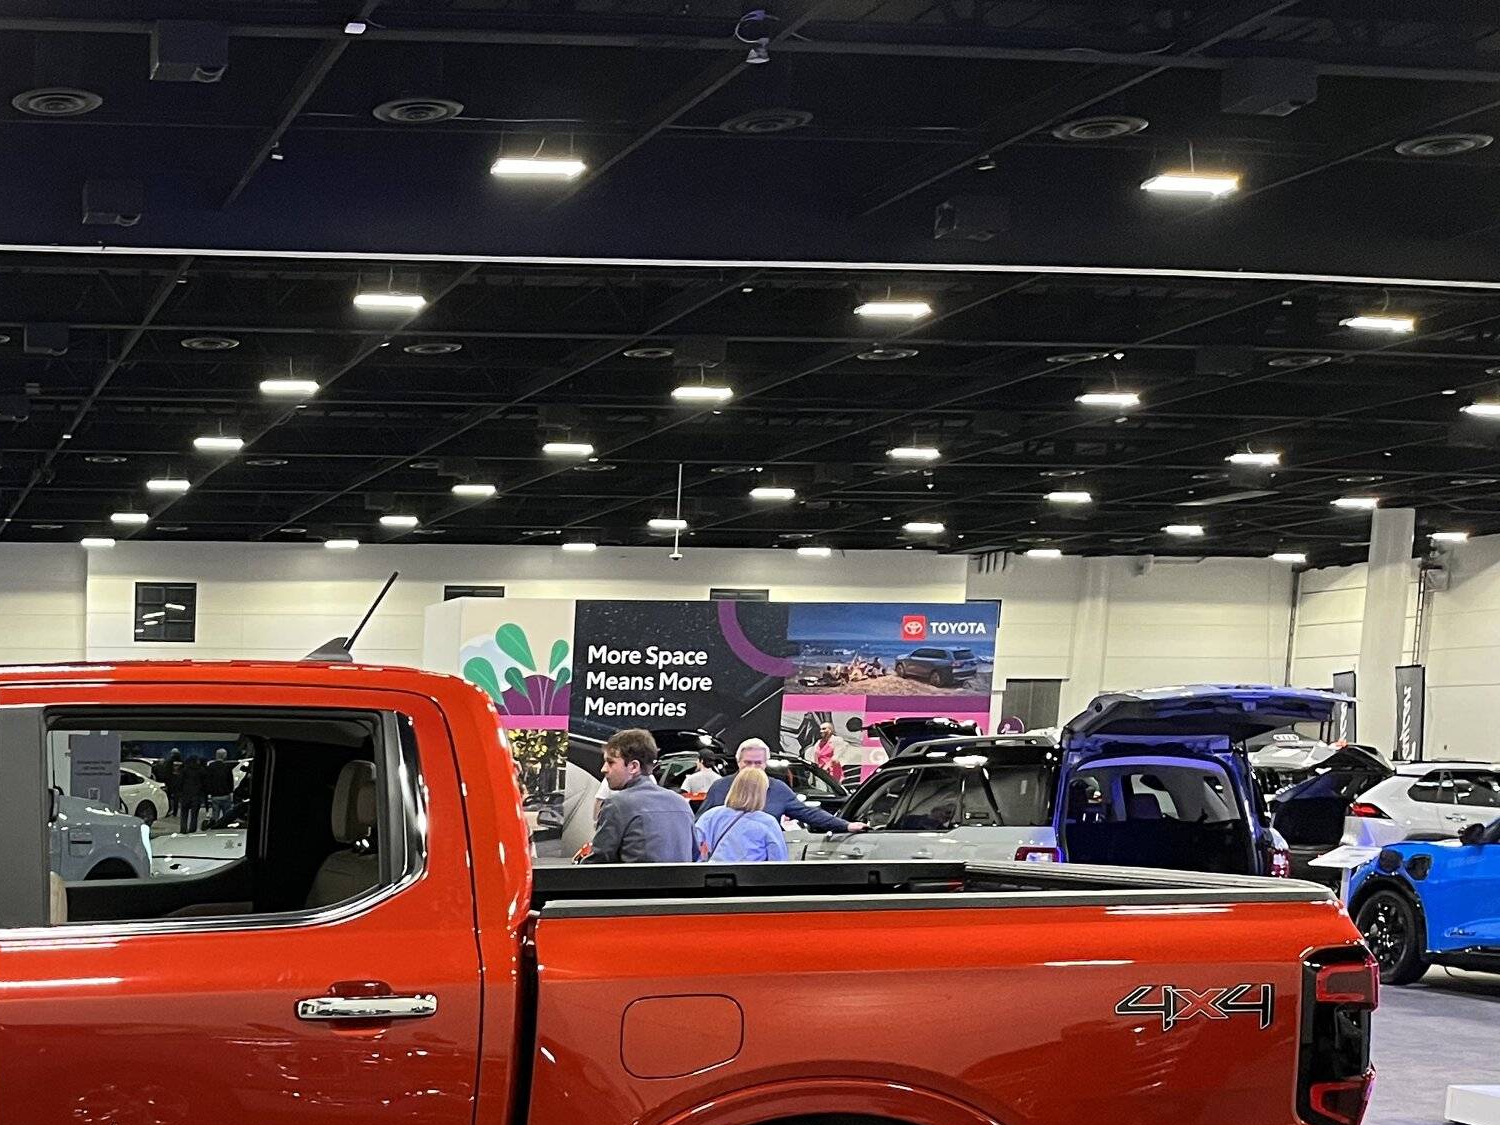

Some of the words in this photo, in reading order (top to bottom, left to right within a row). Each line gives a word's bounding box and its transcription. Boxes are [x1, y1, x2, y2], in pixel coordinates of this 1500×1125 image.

[929, 622, 987, 635] TOYOTA
[587, 644, 642, 665] More
[645, 645, 708, 670] Space
[586, 671, 654, 690] Means
[658, 671, 713, 691] More
[584, 695, 687, 717] Memories
